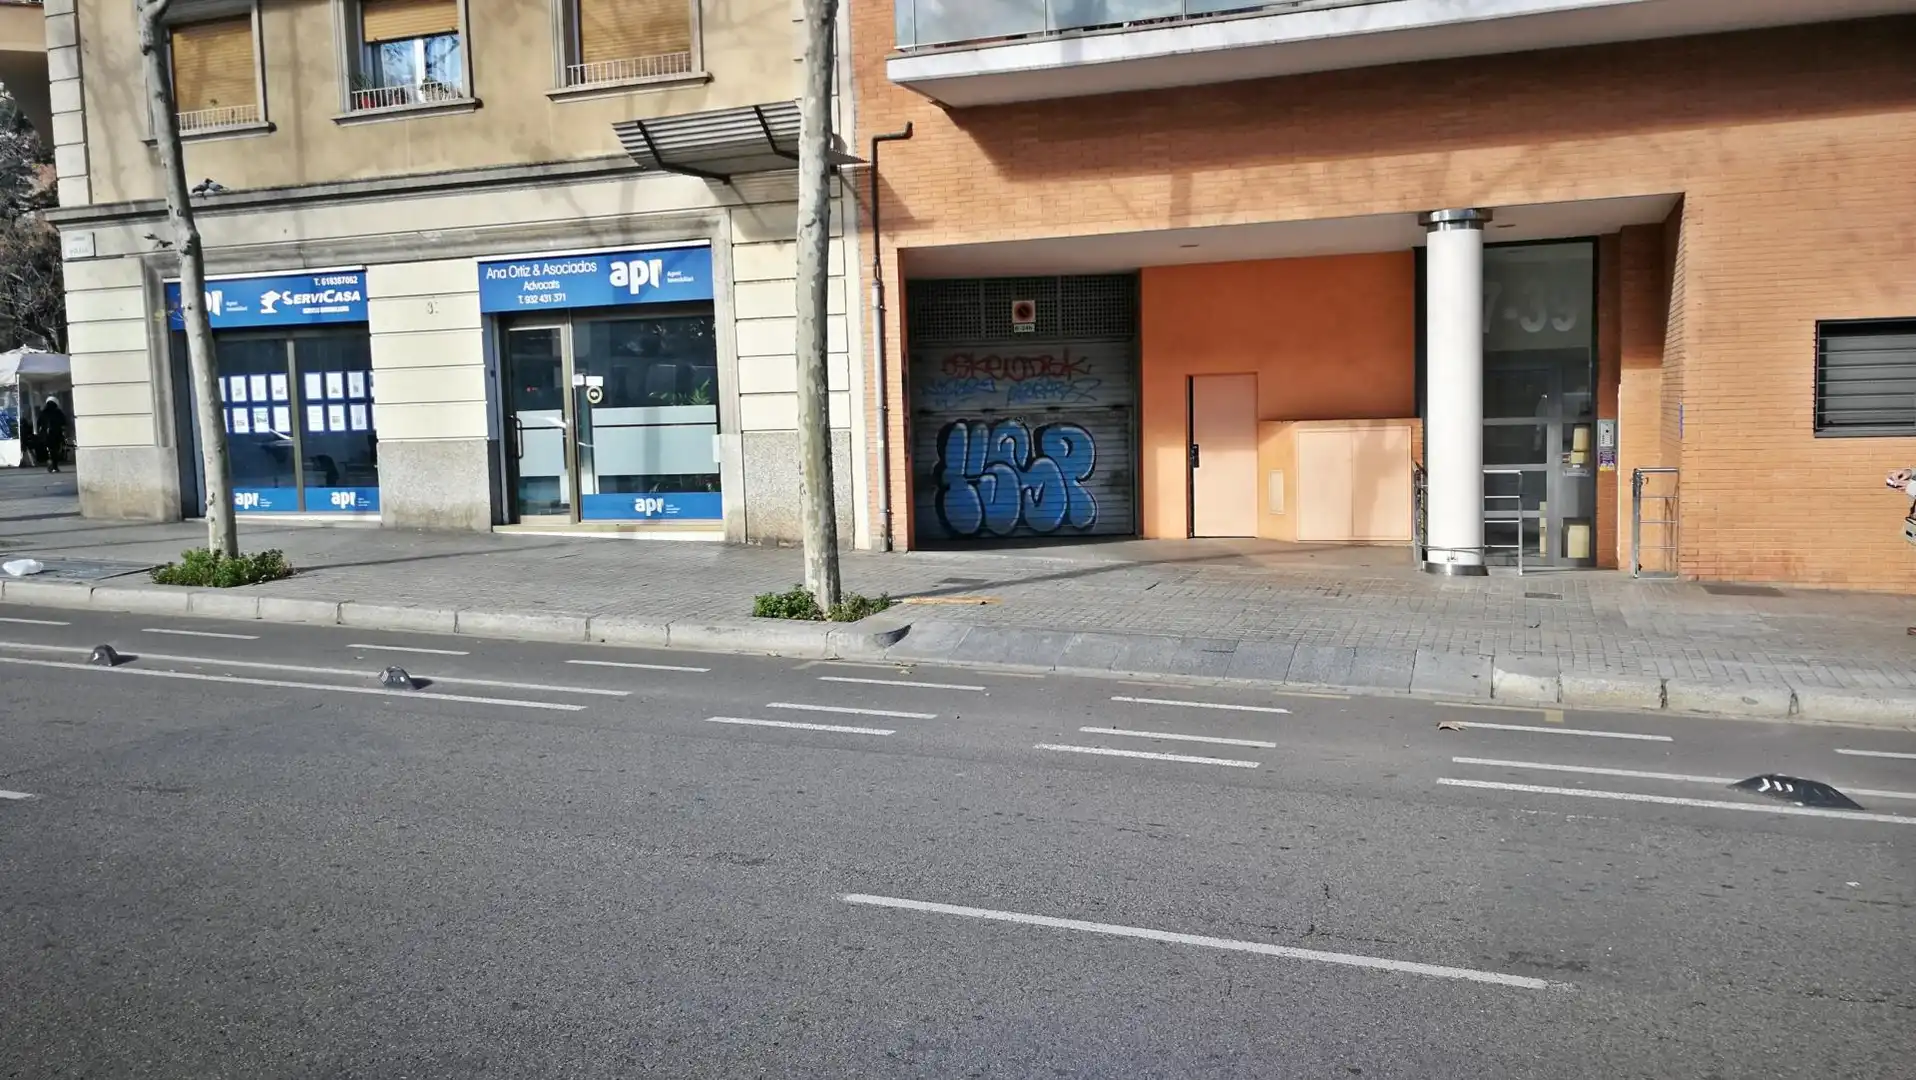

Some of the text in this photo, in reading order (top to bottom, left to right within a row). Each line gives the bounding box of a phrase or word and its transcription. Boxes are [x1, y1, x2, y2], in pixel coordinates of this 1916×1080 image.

[486, 260, 598, 280] Ana Ortiz & Asociados
[523, 280, 560, 291] Advocats
